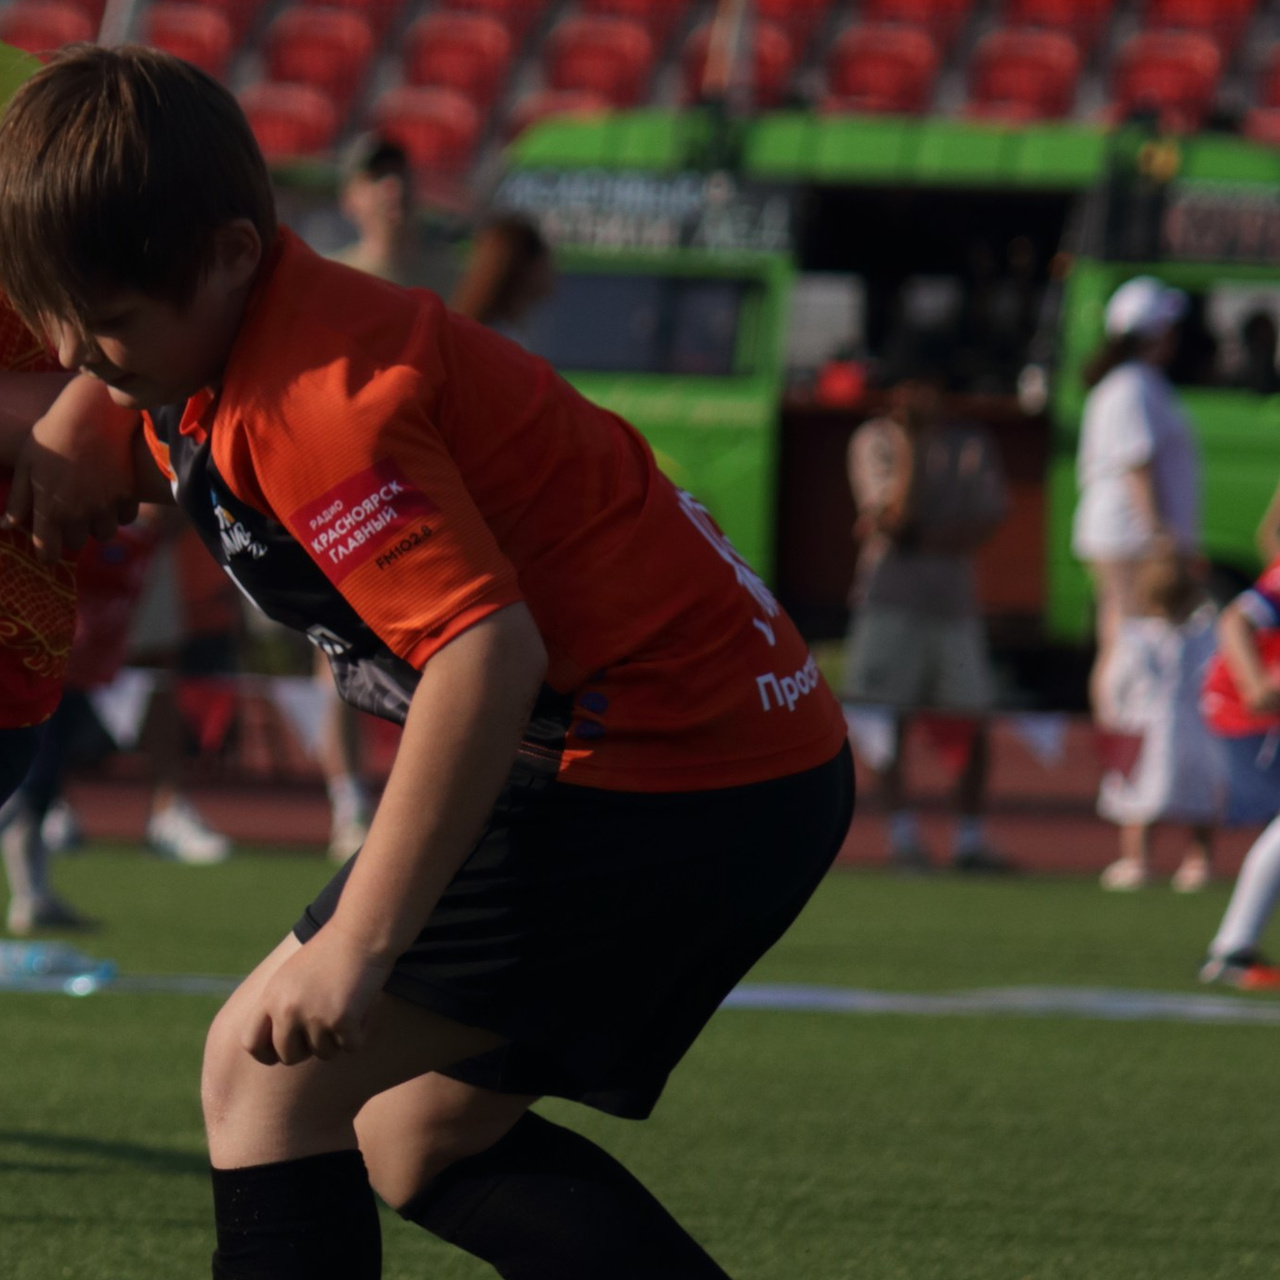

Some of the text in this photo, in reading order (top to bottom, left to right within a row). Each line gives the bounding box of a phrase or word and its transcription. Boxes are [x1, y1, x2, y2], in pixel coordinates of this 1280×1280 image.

[309, 499, 343, 530] РАДИО
[311, 480, 404, 554] КРАСНОЯРСК
[328, 505, 398, 564] ГЛАВНЫЙ
[376, 525, 433, 571] FM102.8
